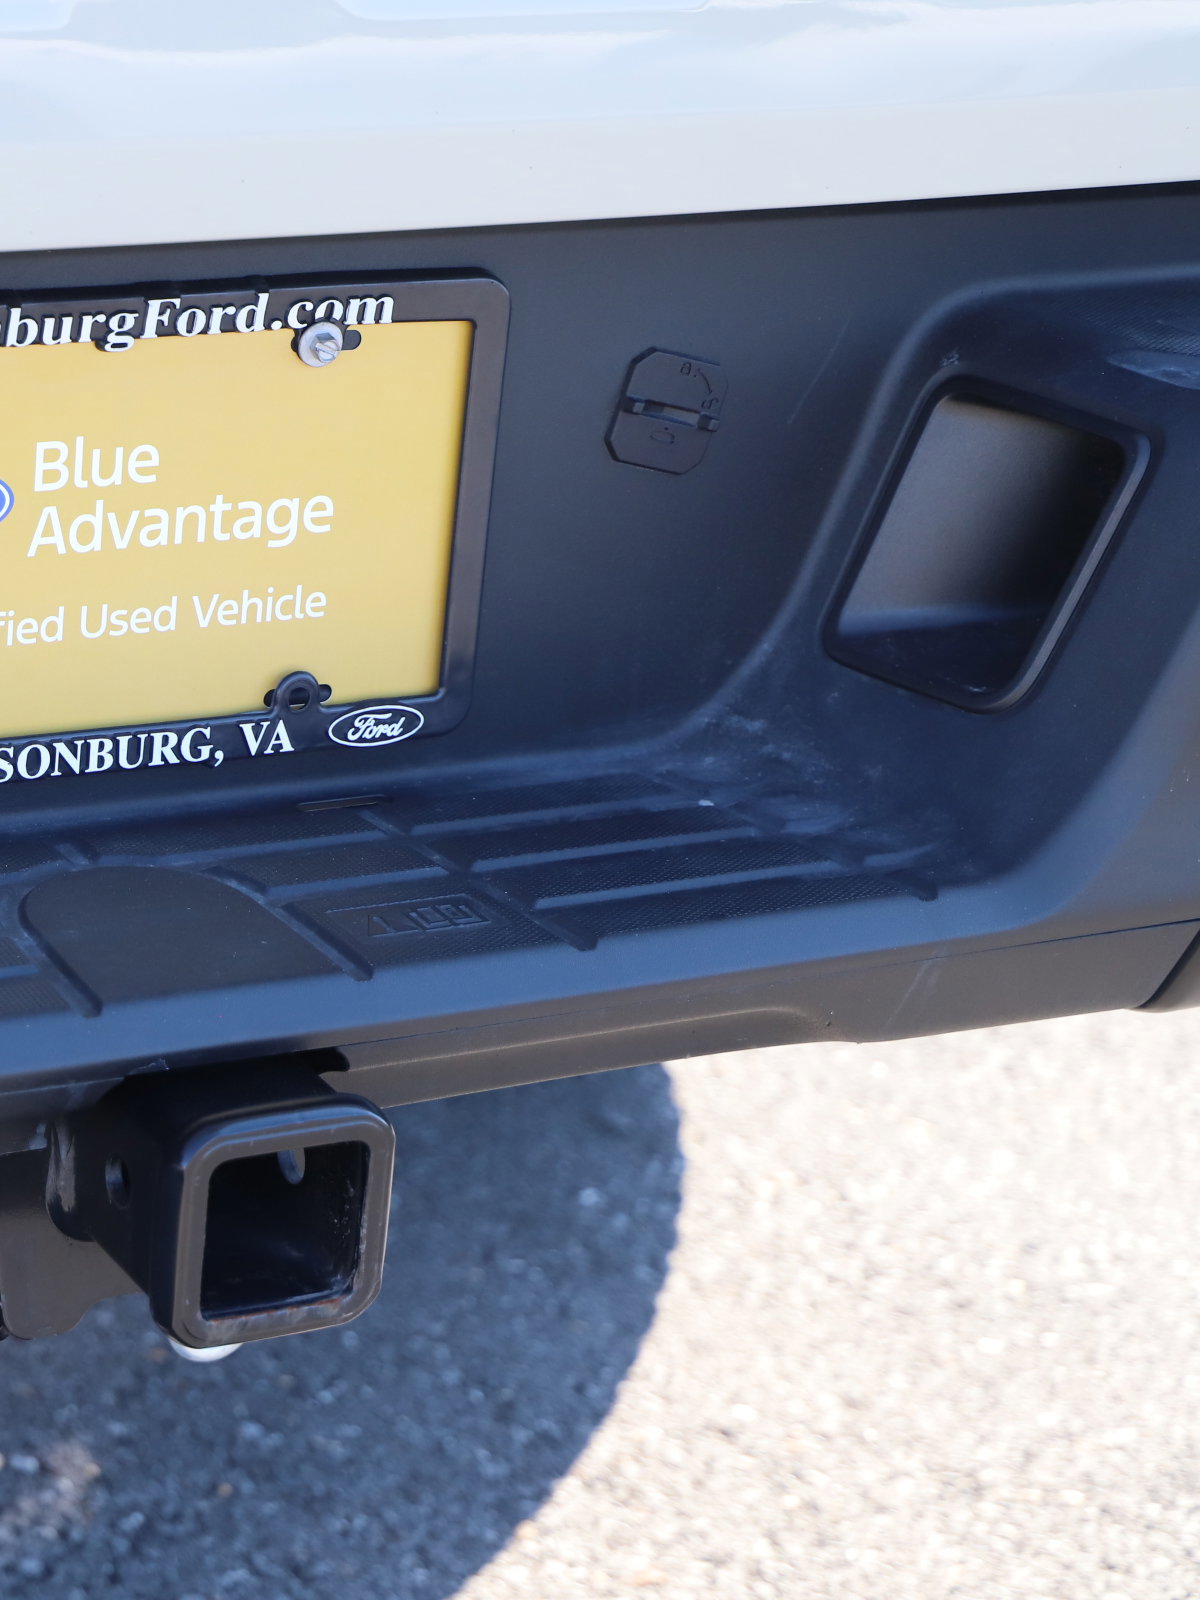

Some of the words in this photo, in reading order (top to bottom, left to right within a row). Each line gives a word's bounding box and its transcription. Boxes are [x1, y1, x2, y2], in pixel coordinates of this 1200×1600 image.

[34, 436, 159, 492] Blue
[27, 493, 333, 557] Advantage
[80, 596, 177, 638] Used
[193, 585, 326, 628] Vehicle
[240, 719, 294, 756] VA
